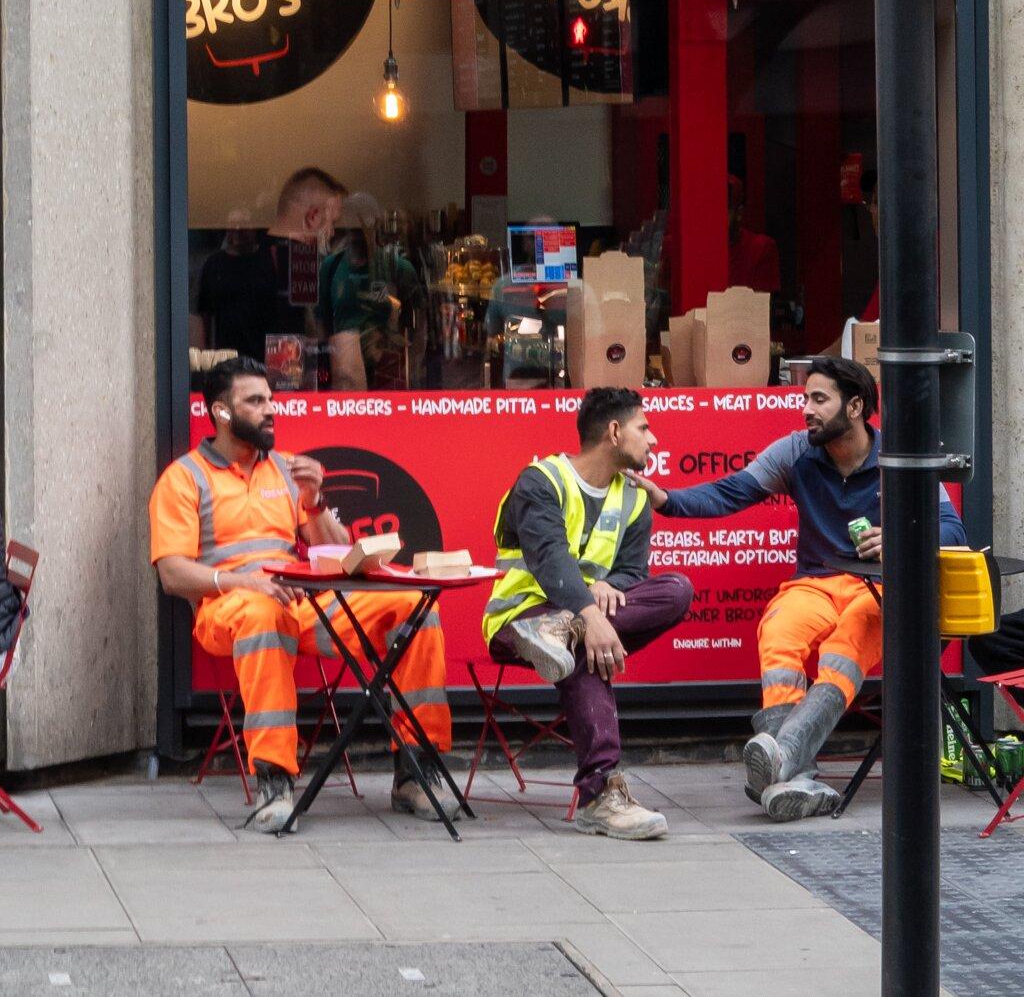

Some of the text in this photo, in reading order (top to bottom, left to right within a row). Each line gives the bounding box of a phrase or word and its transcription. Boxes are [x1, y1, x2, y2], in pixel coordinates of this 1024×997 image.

[326, 398, 393, 417] BURGERS
[411, 396, 492, 416] HANDMADE
[495, 397, 537, 415] PITTA
[641, 394, 695, 412] SAUCES
[713, 393, 753, 411] MEAT
[708, 528, 765, 547] HEARTY
[733, 548, 797, 565] OPTIONS
[673, 638, 742, 649] ENQUIRE WITHIN
